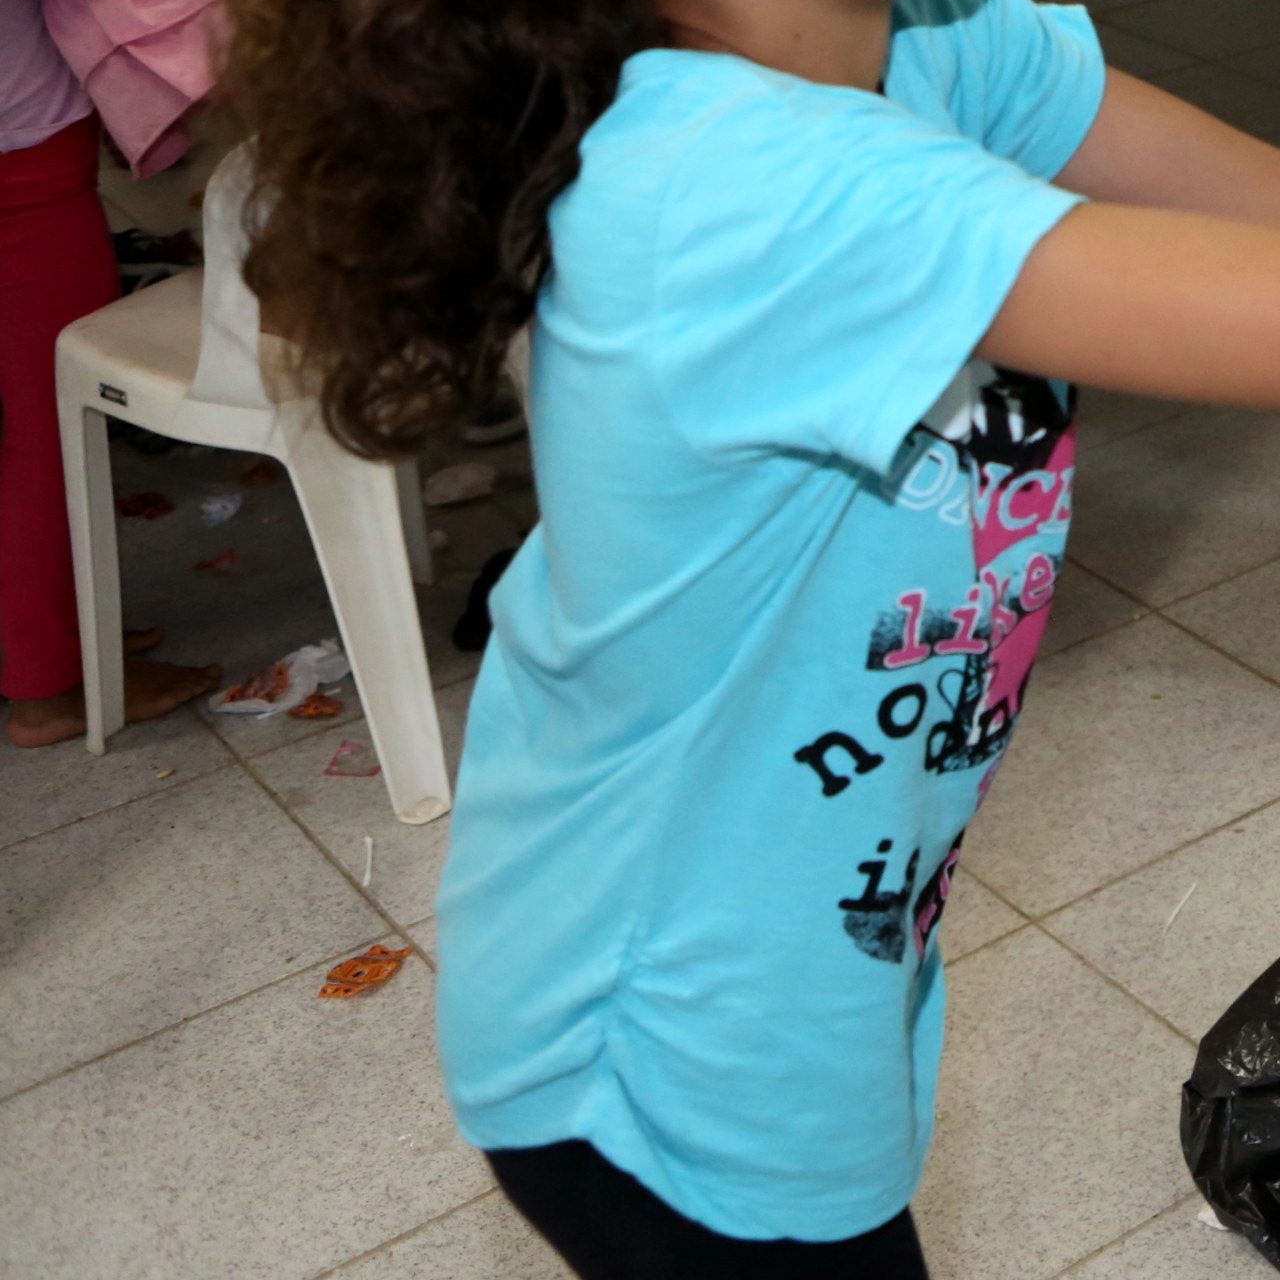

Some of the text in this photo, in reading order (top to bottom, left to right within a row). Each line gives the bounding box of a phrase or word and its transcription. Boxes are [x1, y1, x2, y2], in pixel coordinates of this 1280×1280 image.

[882, 551, 1055, 669] like
[793, 682, 928, 799] no
[838, 838, 921, 911] i
